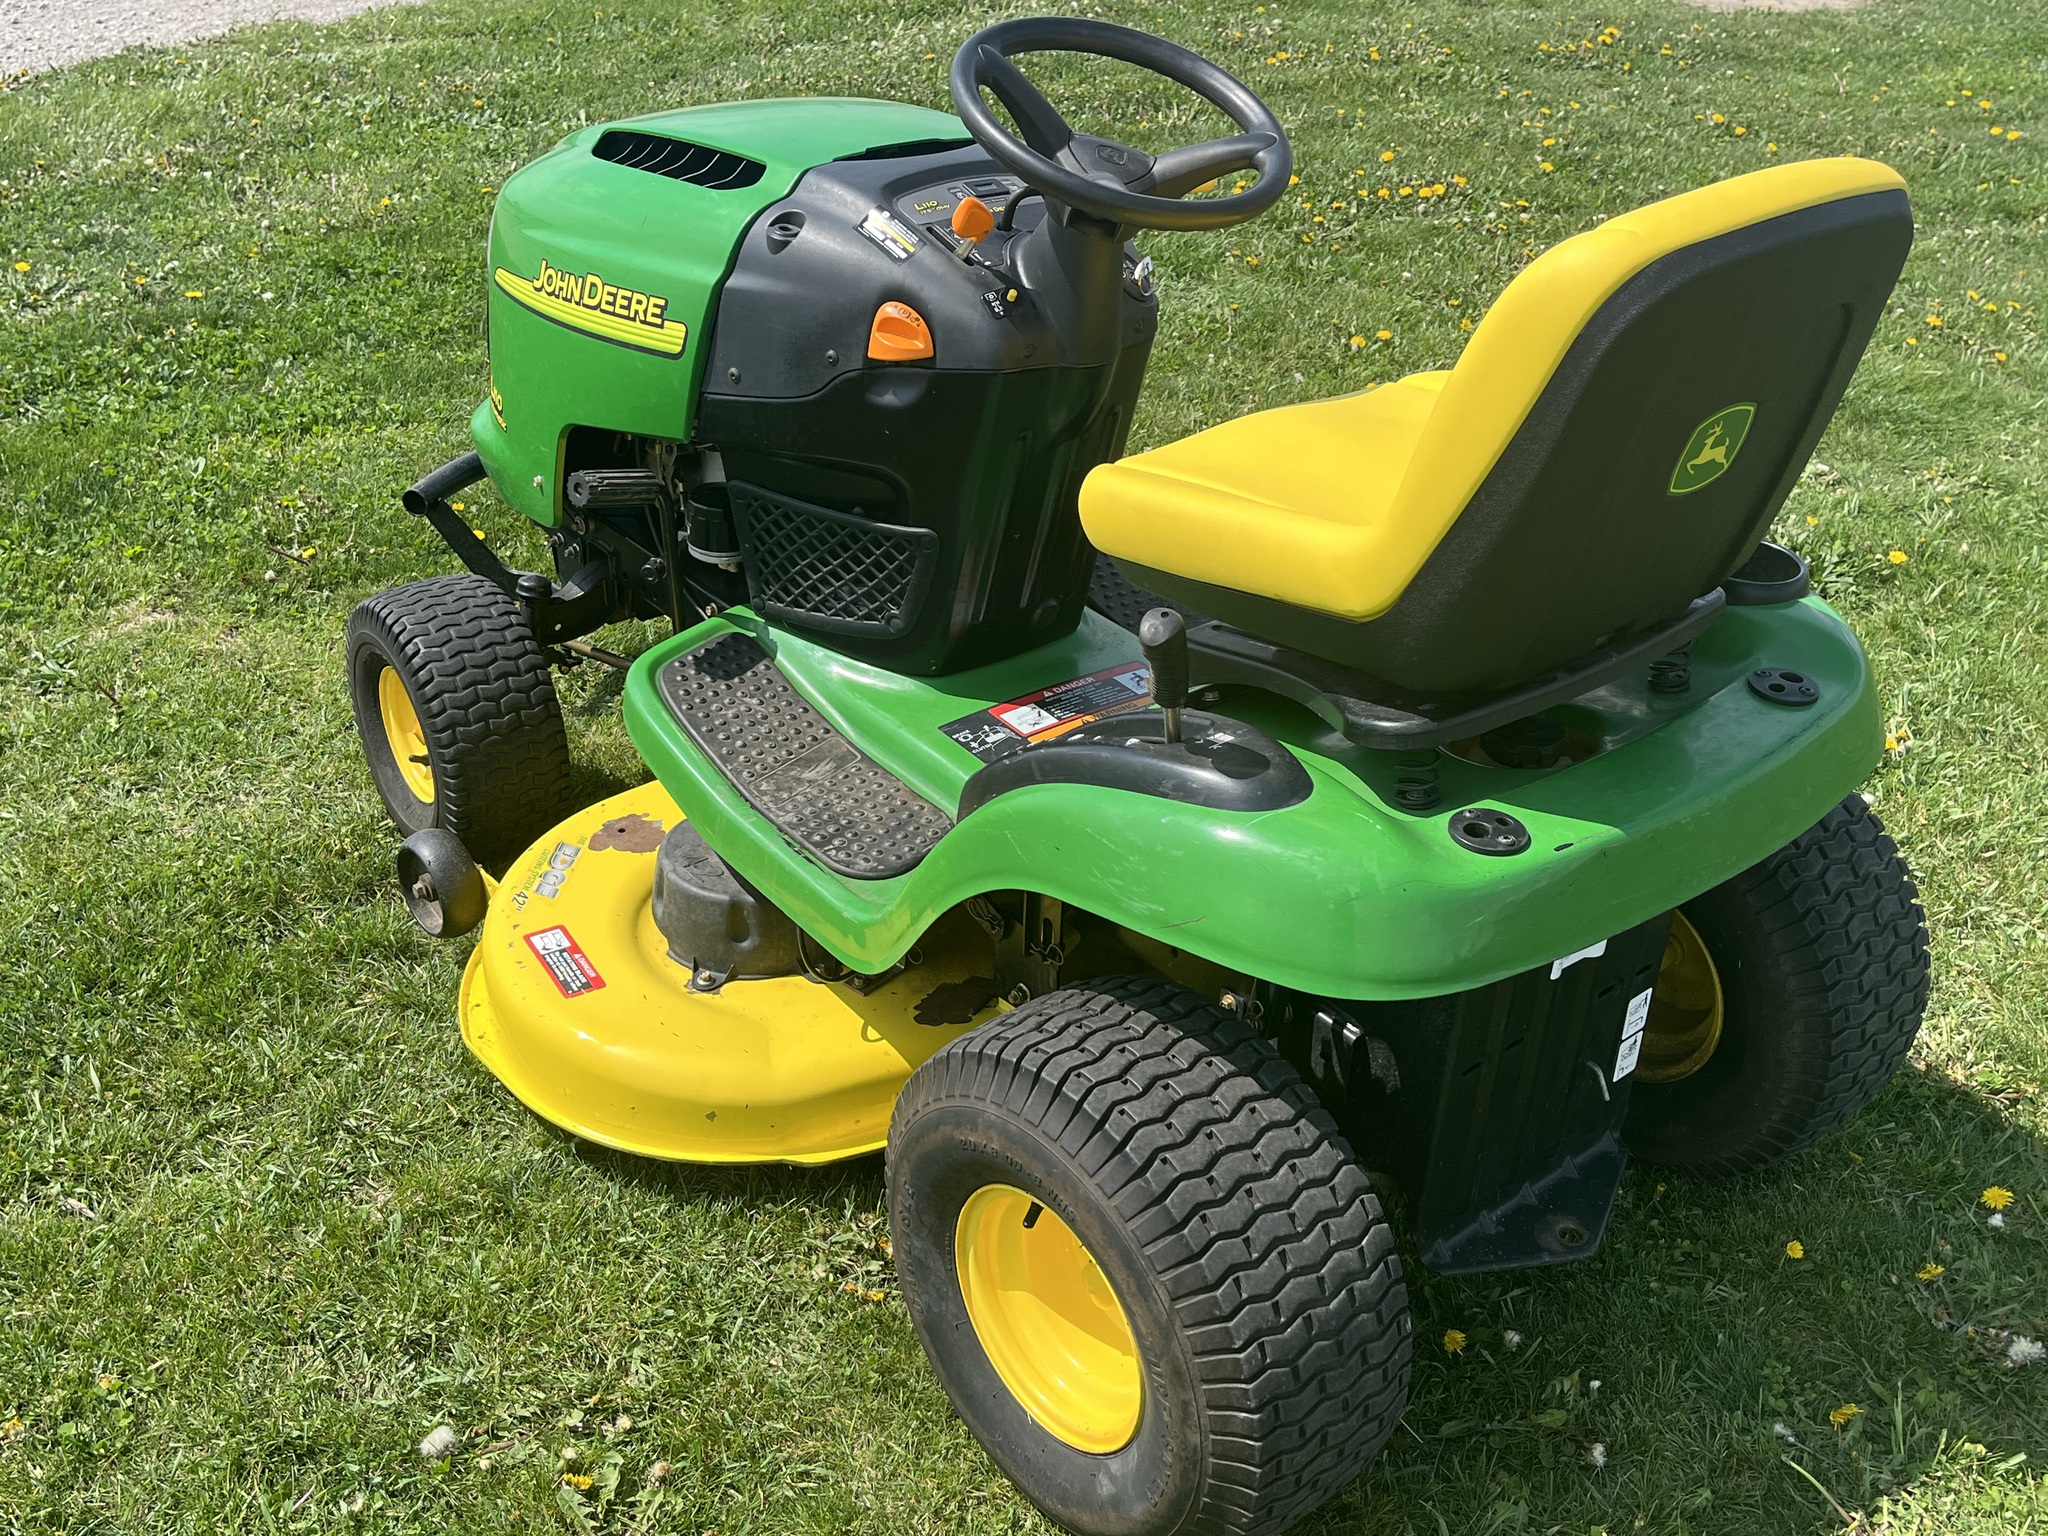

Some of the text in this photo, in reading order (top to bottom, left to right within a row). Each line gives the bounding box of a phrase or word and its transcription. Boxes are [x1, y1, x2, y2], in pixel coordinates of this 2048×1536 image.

[914, 199, 939, 212] L110
[532, 259, 668, 328] JOHN DEERE
[1052, 676, 1096, 694] DANGER
[533, 841, 581, 900] EDGE
